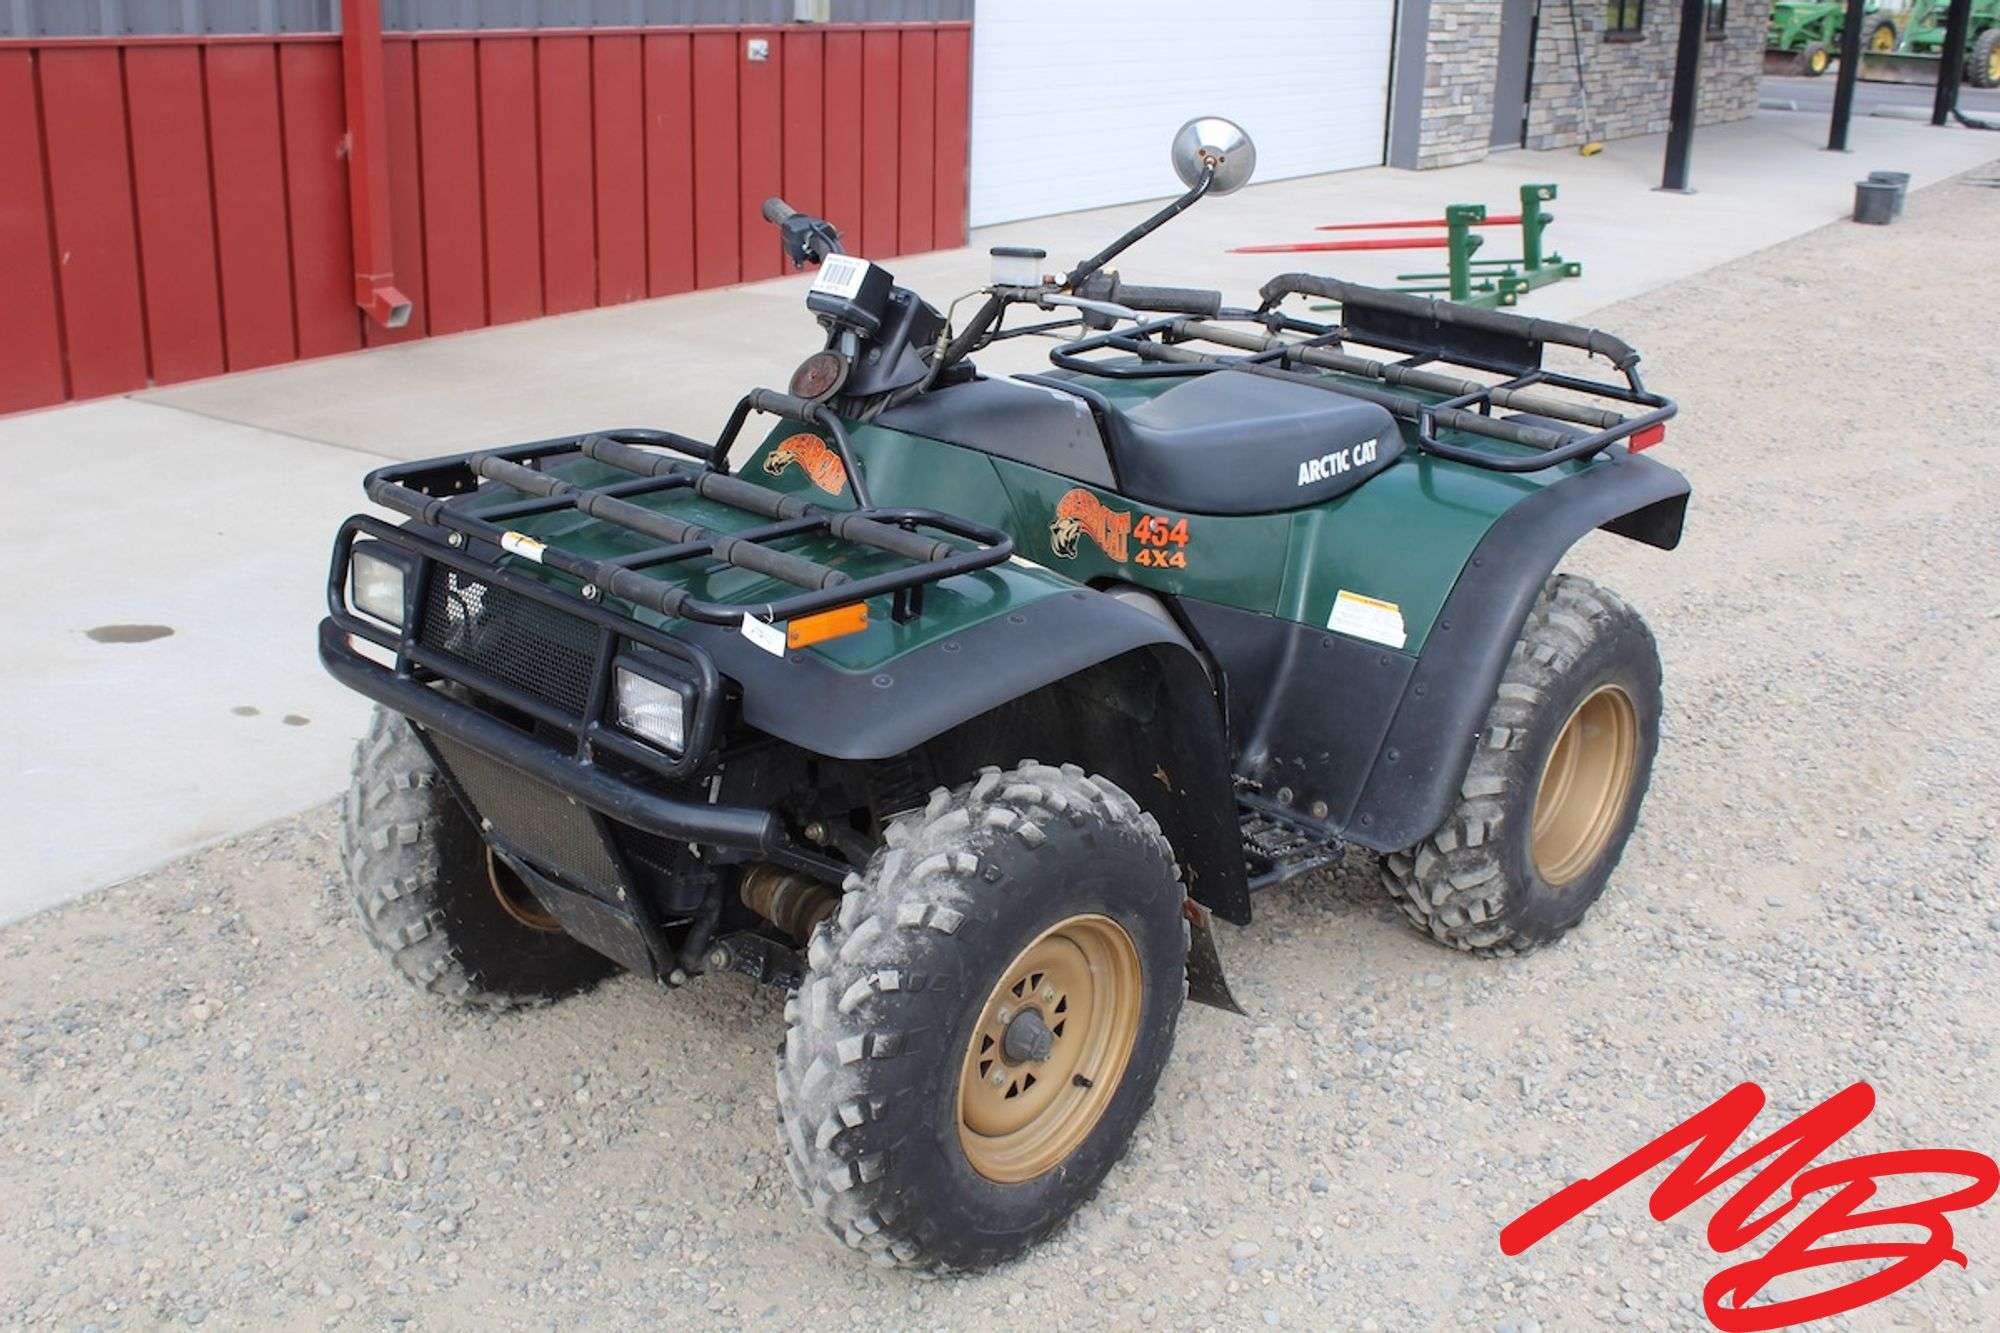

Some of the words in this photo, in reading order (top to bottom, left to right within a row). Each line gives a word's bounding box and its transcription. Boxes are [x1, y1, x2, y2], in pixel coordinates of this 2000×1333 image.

[1298, 449, 1350, 487] ARCTIC
[1352, 438, 1377, 467] CAT
[1133, 514, 1190, 548] 454
